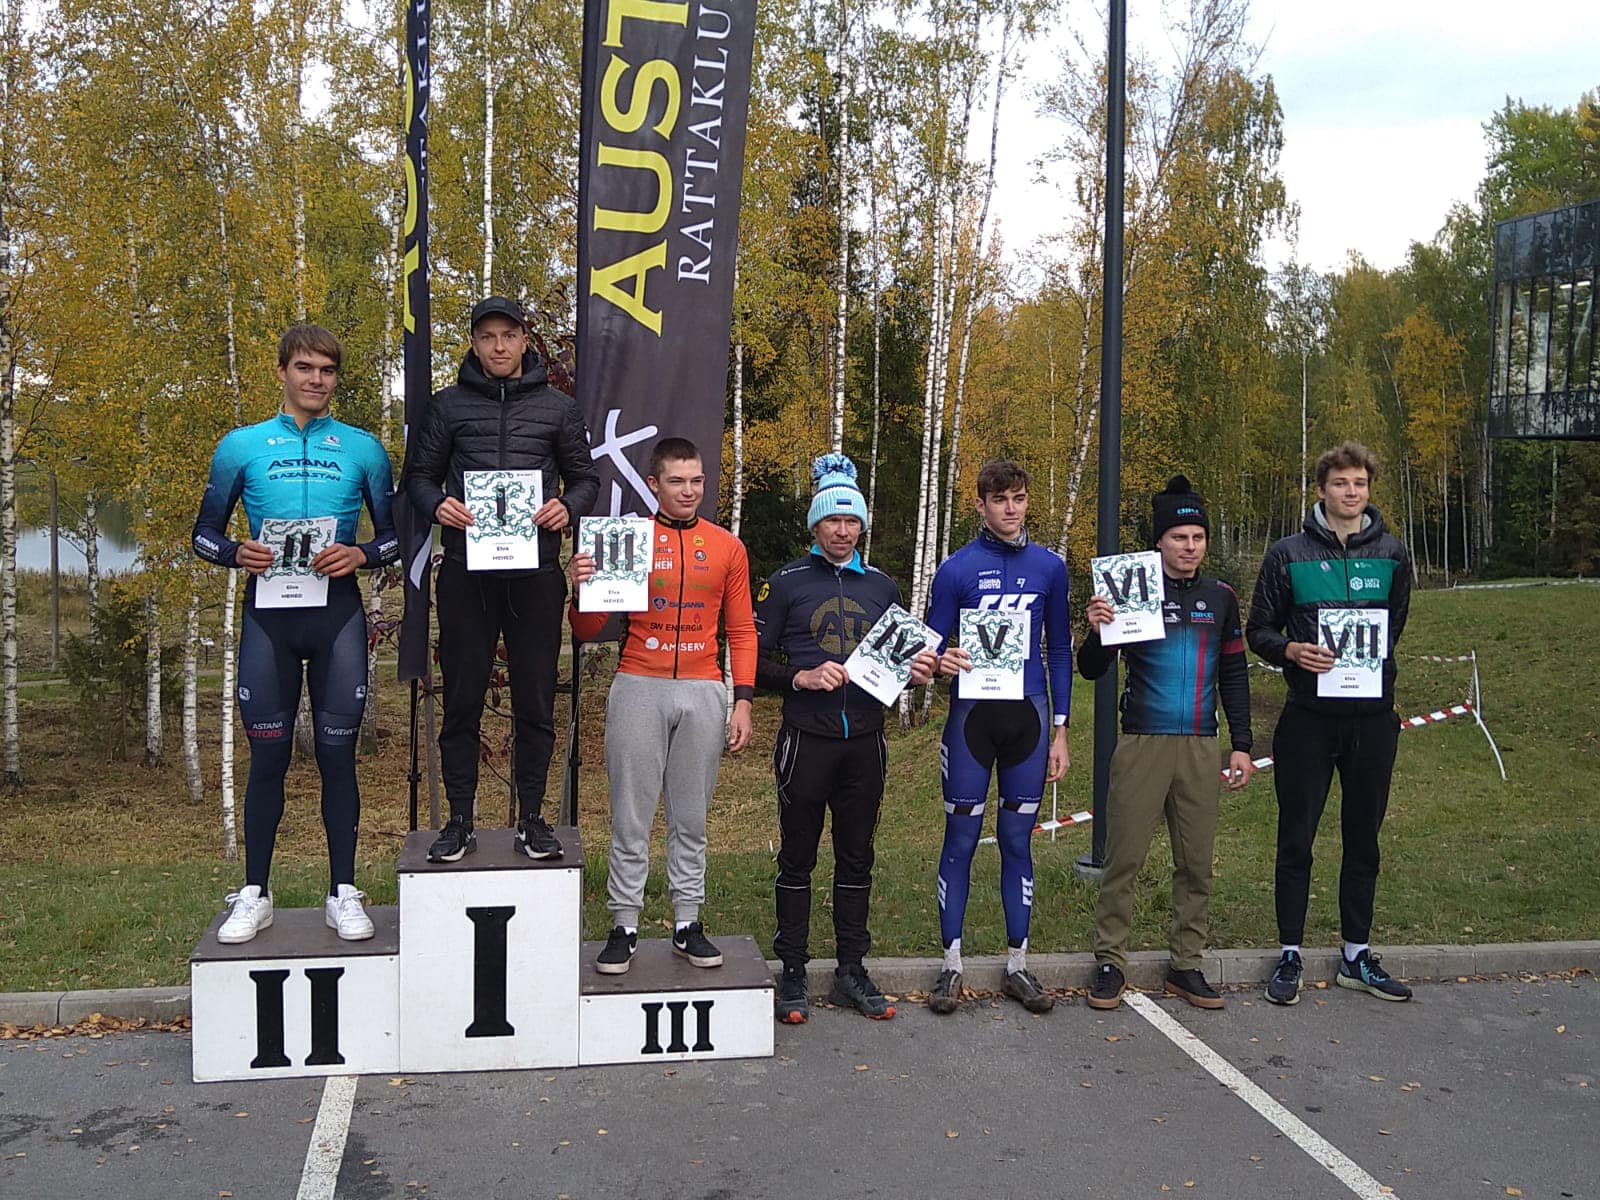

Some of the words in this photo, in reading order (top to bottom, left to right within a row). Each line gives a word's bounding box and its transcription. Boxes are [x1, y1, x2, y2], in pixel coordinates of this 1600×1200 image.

[267, 459, 343, 472] ASTANA
[464, 905, 516, 1038] I
[248, 967, 346, 1069] II
[640, 999, 714, 1054] III
